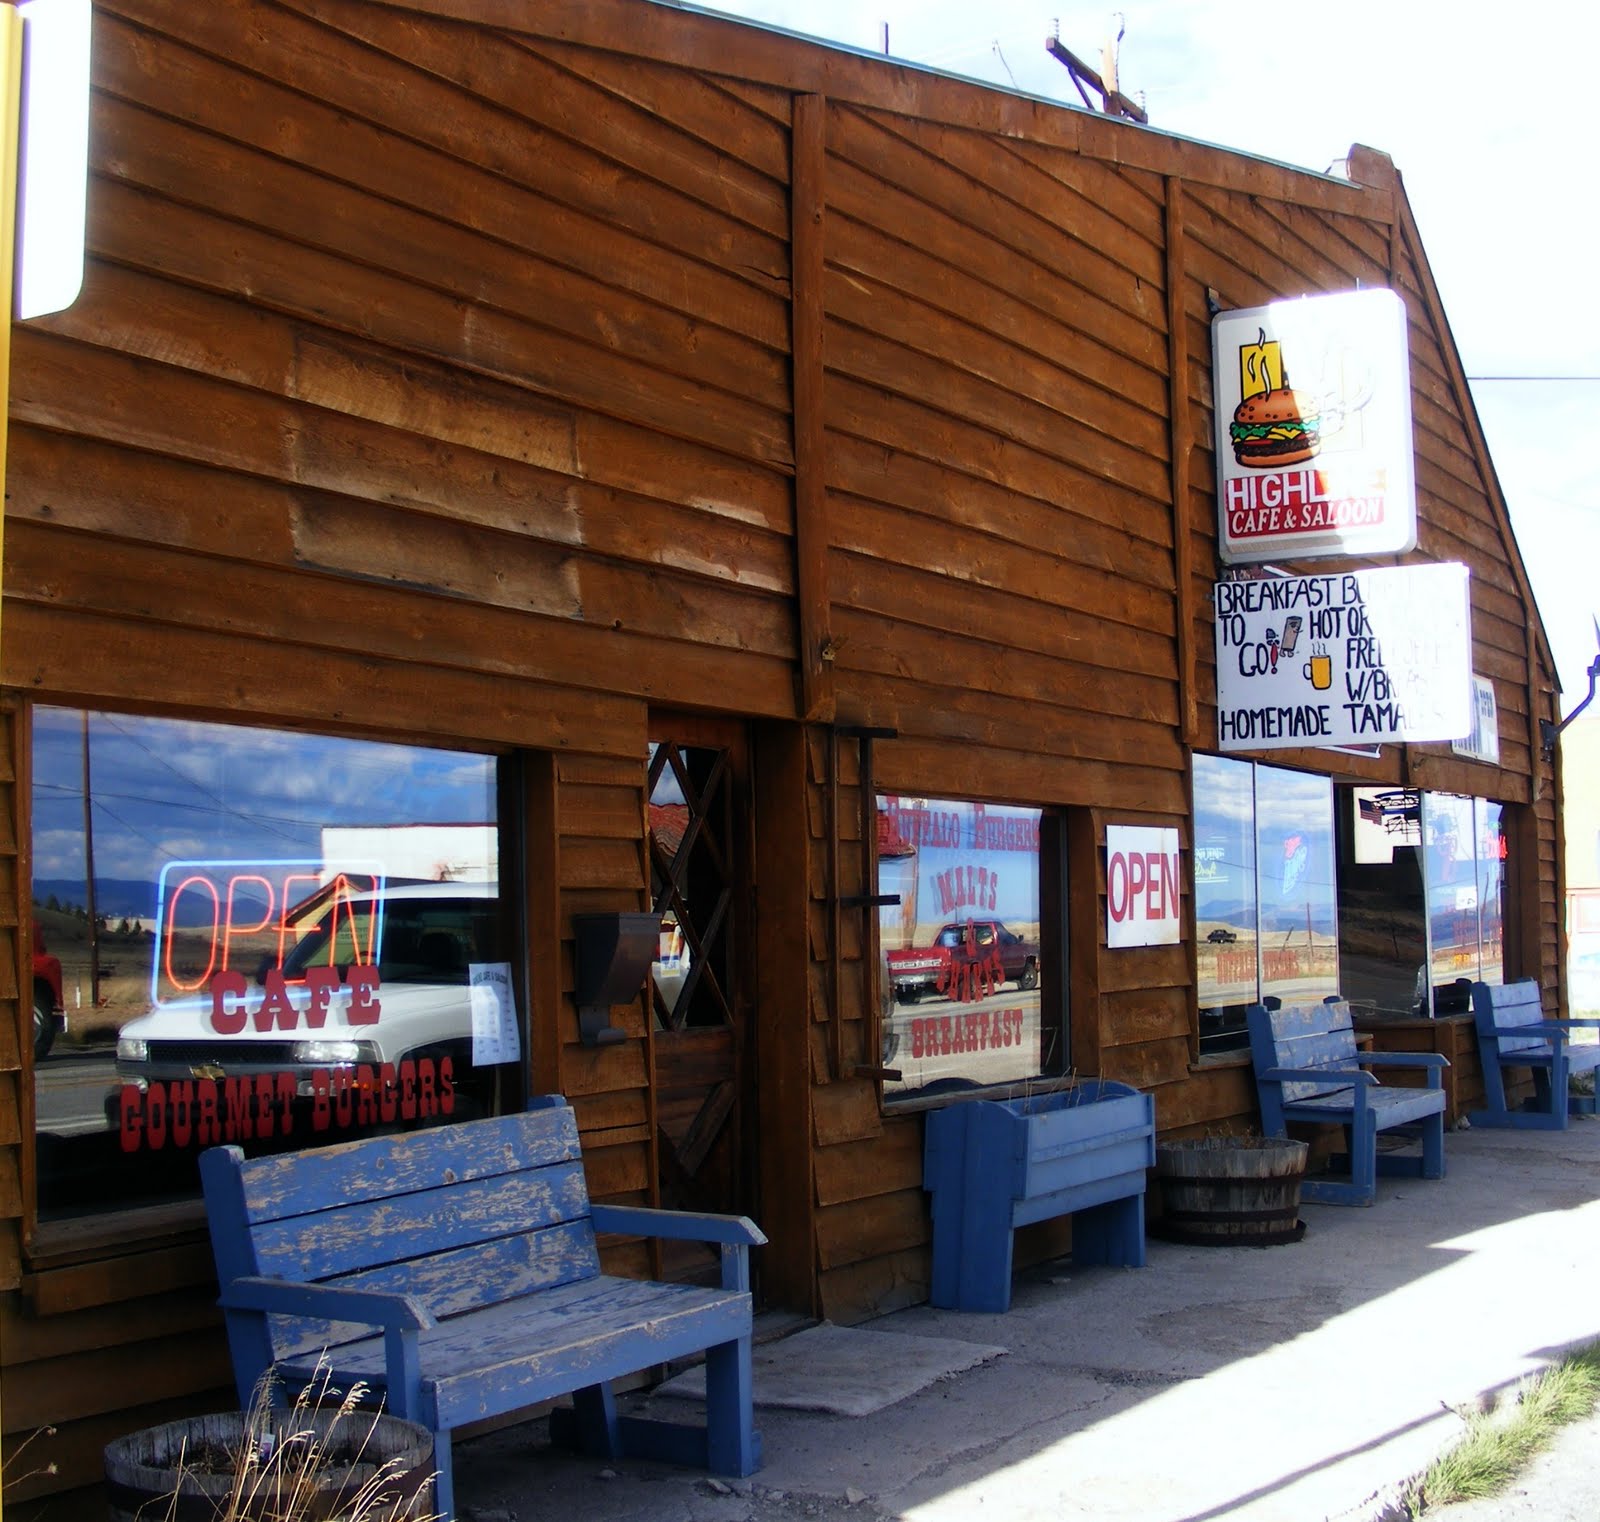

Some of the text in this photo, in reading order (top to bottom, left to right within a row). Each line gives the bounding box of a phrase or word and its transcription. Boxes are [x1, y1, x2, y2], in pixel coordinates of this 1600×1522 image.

[1232, 497, 1379, 534] CAFE & SALOON
[1217, 578, 1337, 615] BREAKFAST
[1218, 613, 1247, 647] TO
[1309, 606, 1346, 640] HOT
[1220, 704, 1333, 742] HOMEMADE
[936, 864, 998, 916] MALTS
[1107, 850, 1179, 924] OPEN
[165, 874, 379, 991] OPEN
[210, 964, 383, 1035] CAFE
[911, 1008, 1024, 1060] BREAKFAST
[119, 1055, 457, 1153] GOURMET BURGERS
